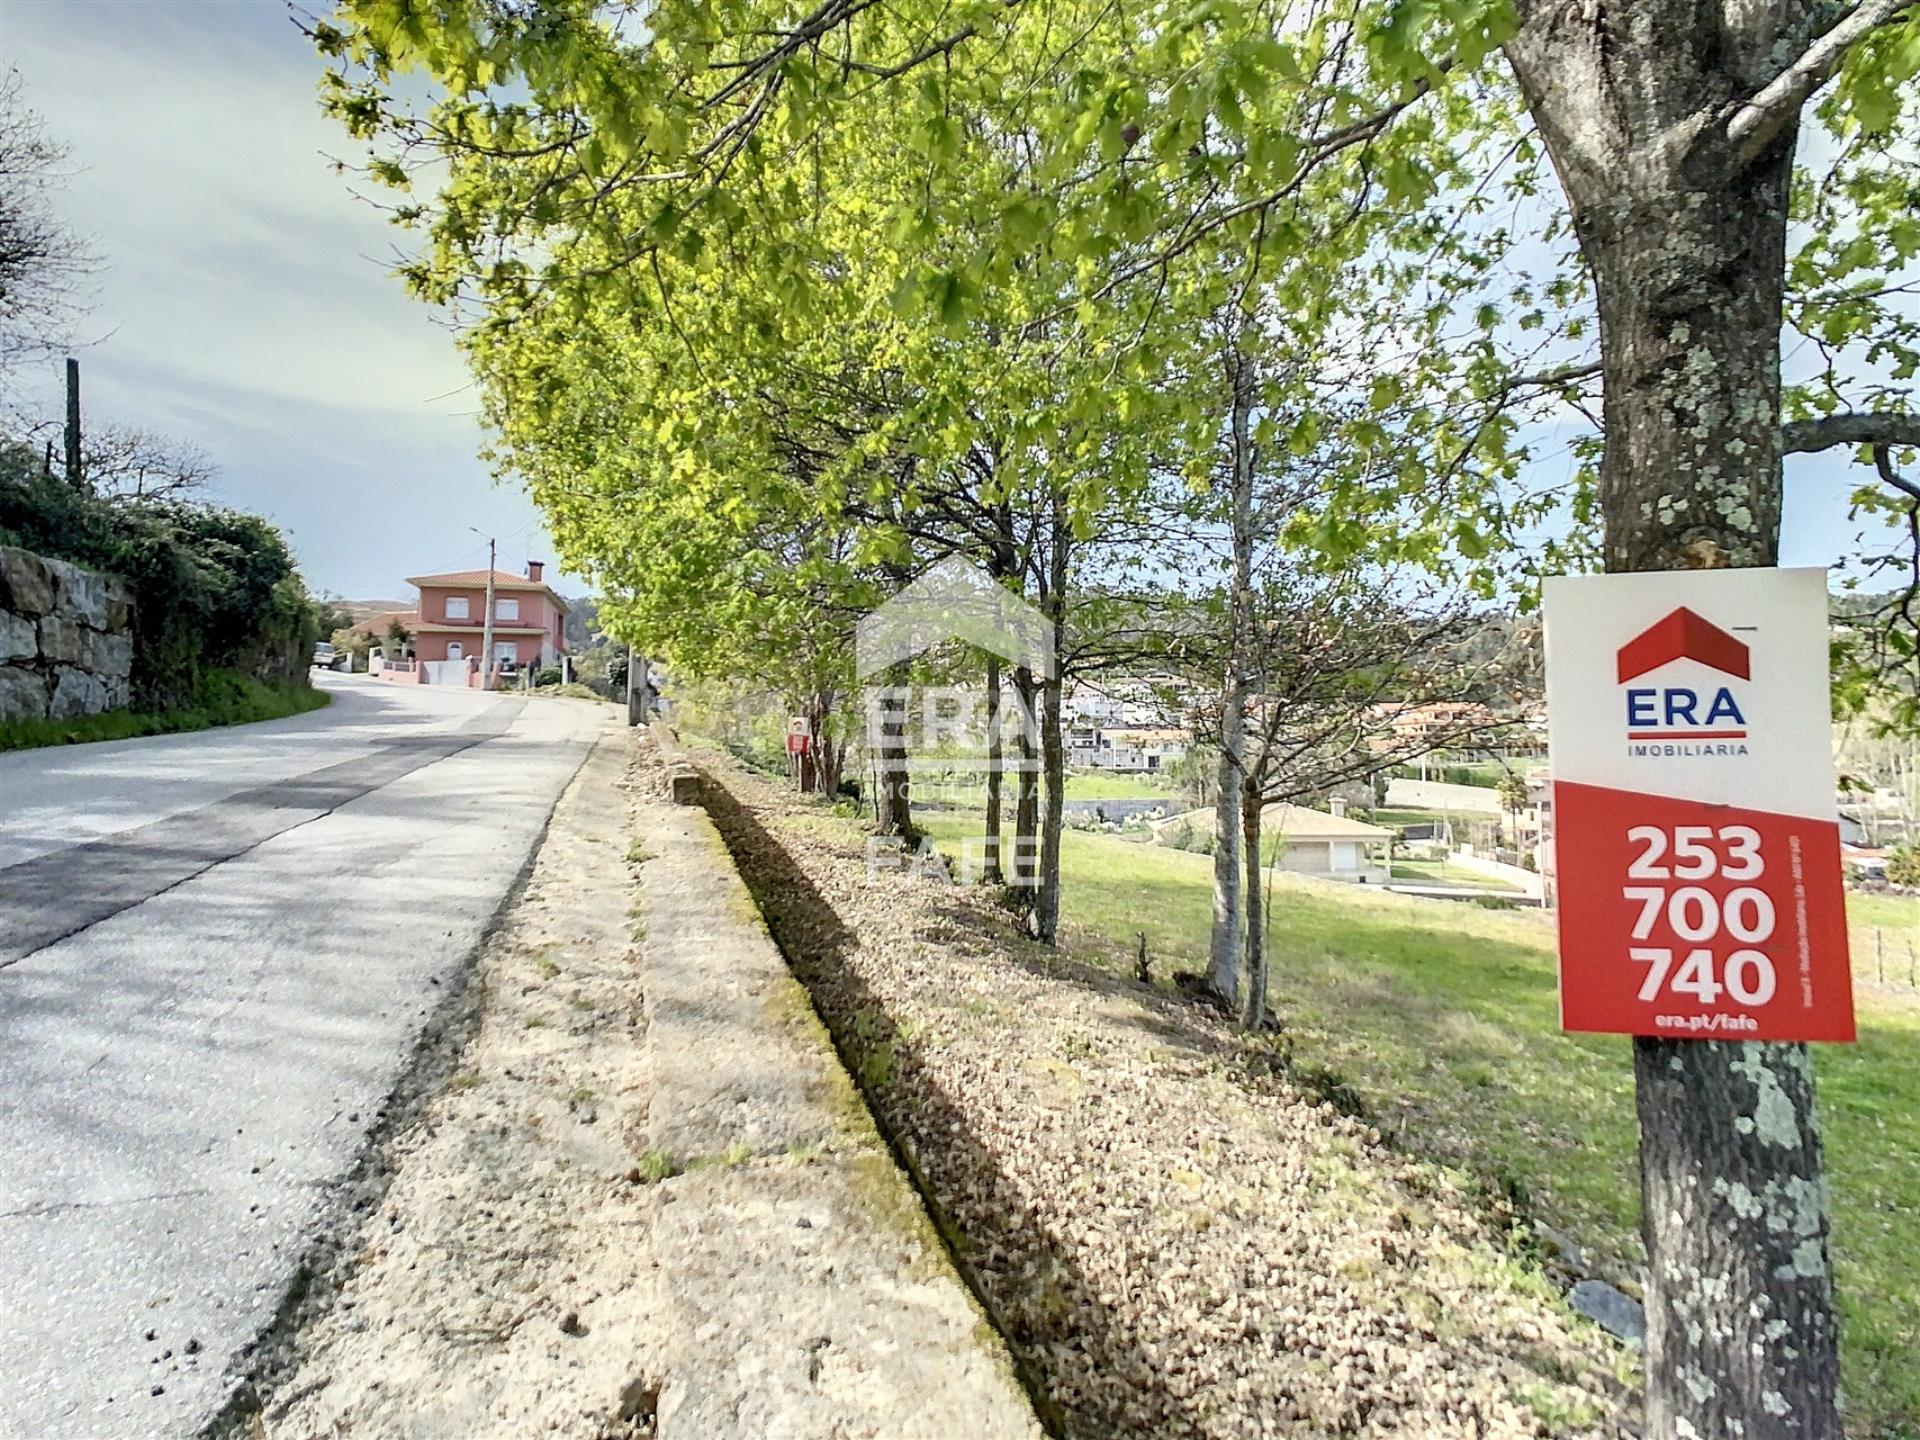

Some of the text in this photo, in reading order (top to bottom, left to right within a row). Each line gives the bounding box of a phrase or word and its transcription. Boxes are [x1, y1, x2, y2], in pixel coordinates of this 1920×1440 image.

[1627, 687, 1746, 726] ERA
[1628, 744, 1749, 757] IMOBILIARIA
[1627, 825, 1766, 881] 253
[1622, 886, 1776, 944] 700
[1629, 947, 1777, 1007] 740
[1655, 1013, 1759, 1032] era.pt/fafe
